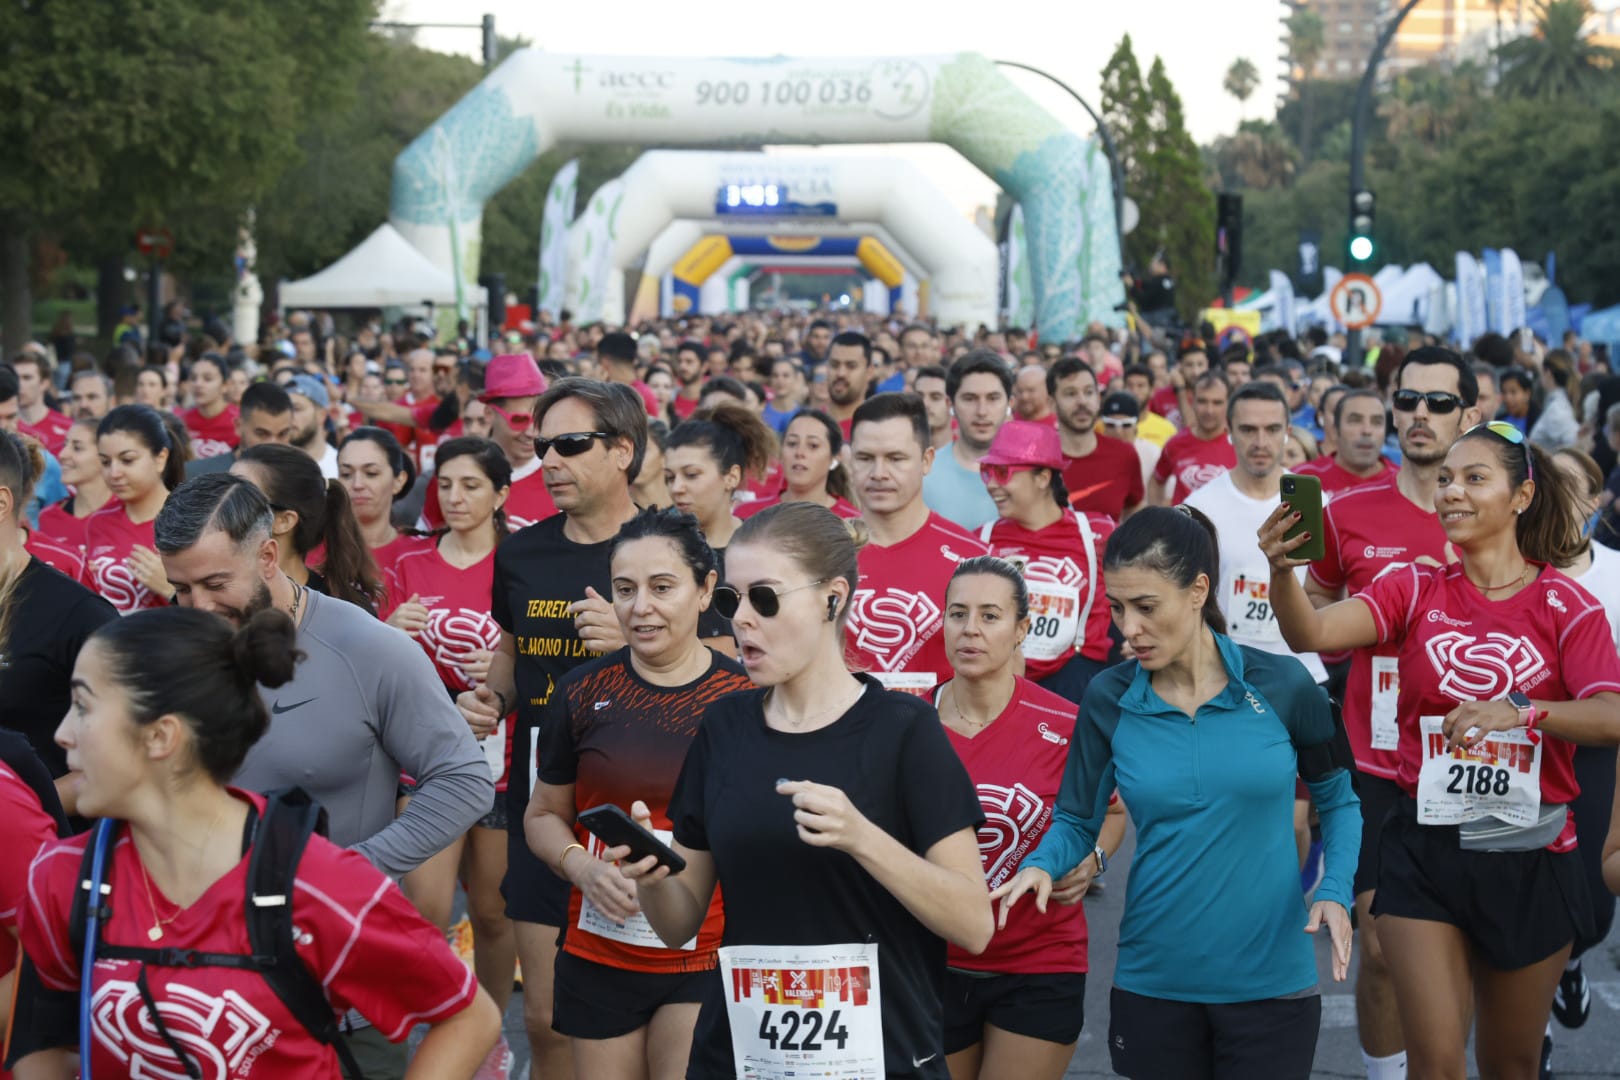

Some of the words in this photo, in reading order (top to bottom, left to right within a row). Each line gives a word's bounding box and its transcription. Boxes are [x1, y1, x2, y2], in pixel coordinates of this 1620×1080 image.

[696, 81, 751, 105] 900
[760, 81, 812, 105] 100
[818, 80, 873, 104] 036
[527, 600, 572, 618] TERRETA
[527, 637, 562, 656] MONO
[564, 639, 570, 656] I
[573, 640, 588, 656] LA
[1446, 764, 1510, 796] 2188
[1006, 839, 1031, 870] PERSONA
[1028, 806, 1053, 841] SOLIDARIA
[785, 989, 815, 998] VALENCIA
[759, 1010, 848, 1051] 4224
[237, 1028, 282, 1078] SOLIDARIA
